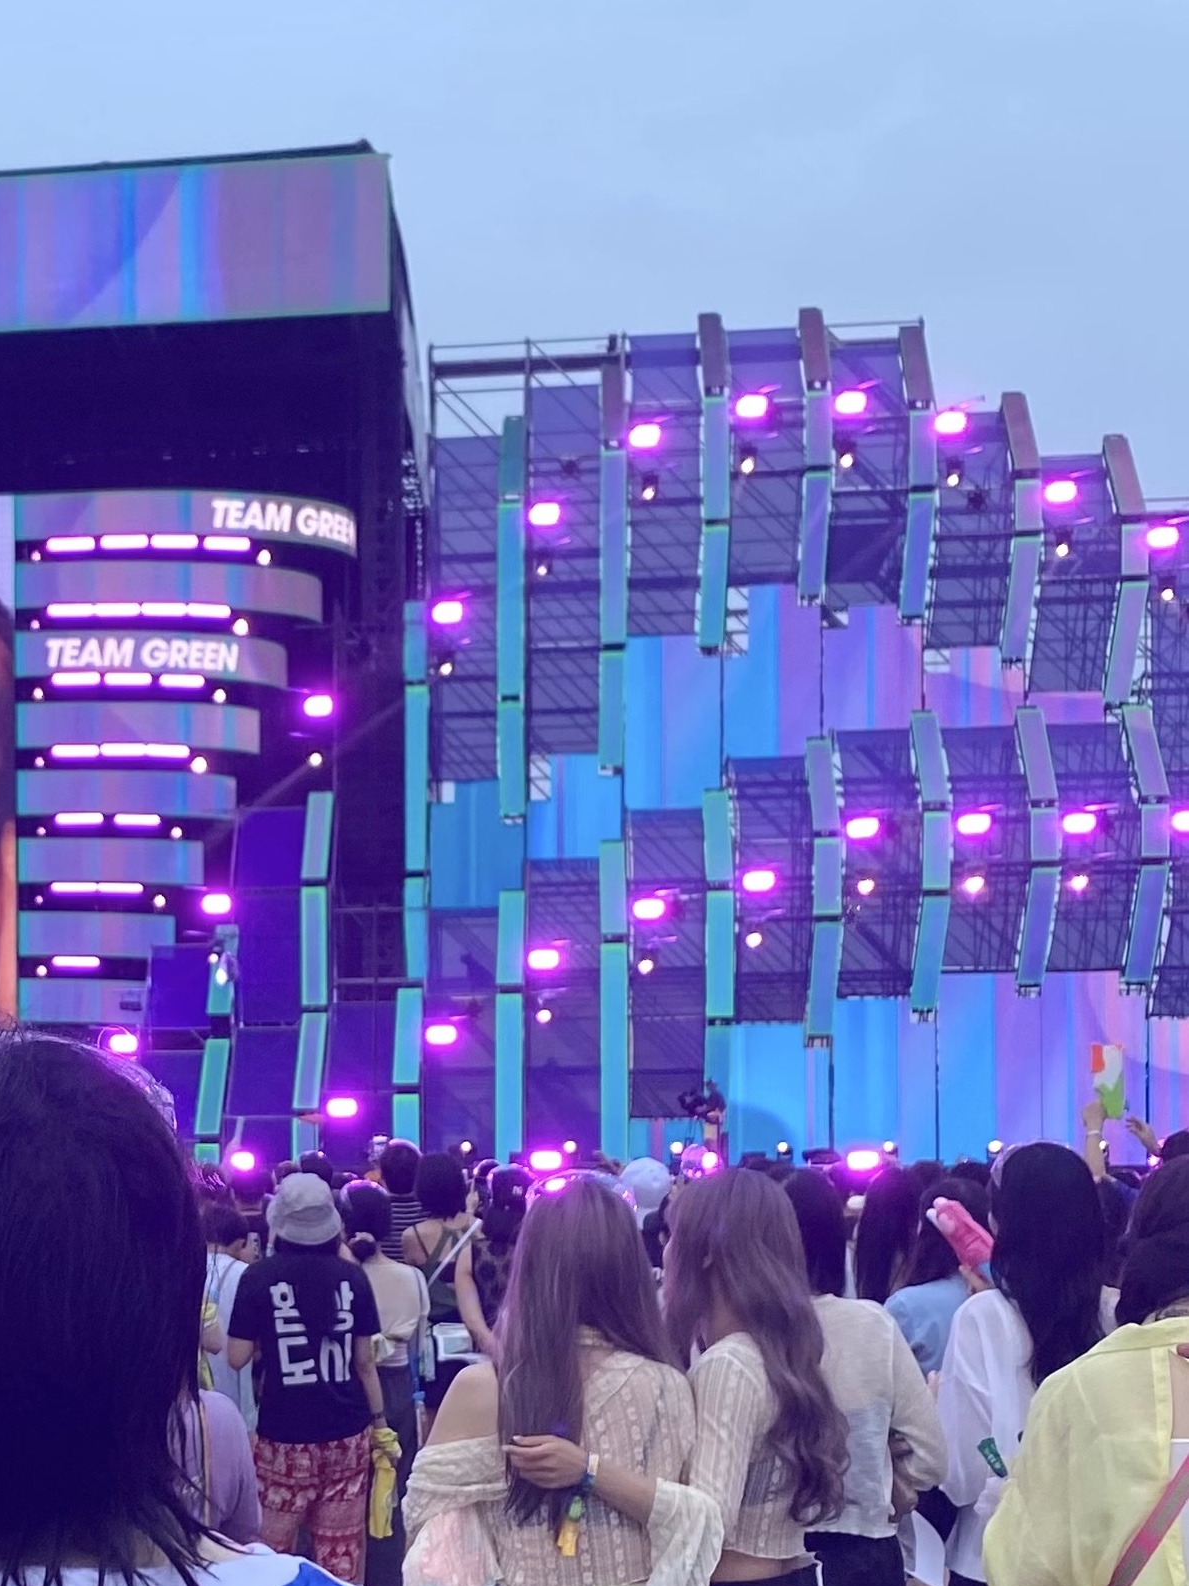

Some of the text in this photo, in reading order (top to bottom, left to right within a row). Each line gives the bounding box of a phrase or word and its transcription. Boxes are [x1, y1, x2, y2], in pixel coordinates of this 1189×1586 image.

[212, 499, 292, 533] TEAM
[46, 637, 239, 672] TEAM GREEN
